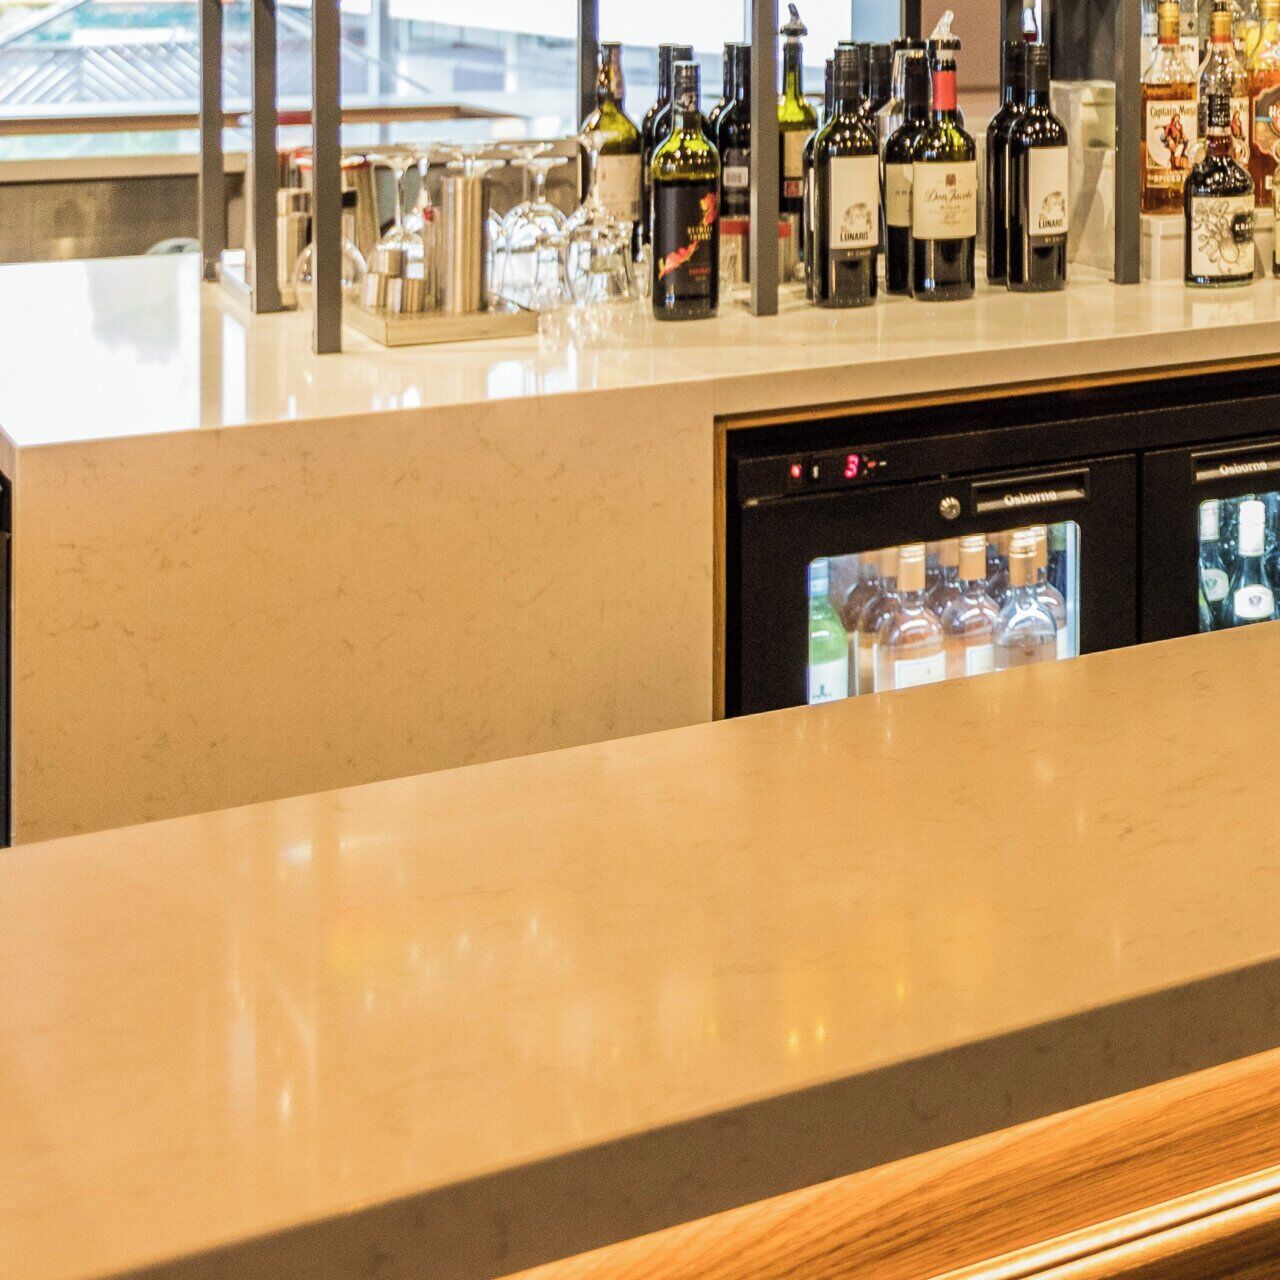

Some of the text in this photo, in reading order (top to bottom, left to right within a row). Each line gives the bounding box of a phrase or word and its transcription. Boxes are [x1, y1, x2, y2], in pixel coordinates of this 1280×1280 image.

[1150, 104, 1177, 118] Captain
[924, 189, 948, 203] Don
[840, 231, 869, 242] LUNARIS
[844, 453, 860, 480] 3
[1218, 459, 1268, 477] Osborne
[1003, 489, 1058, 507] Osborne
